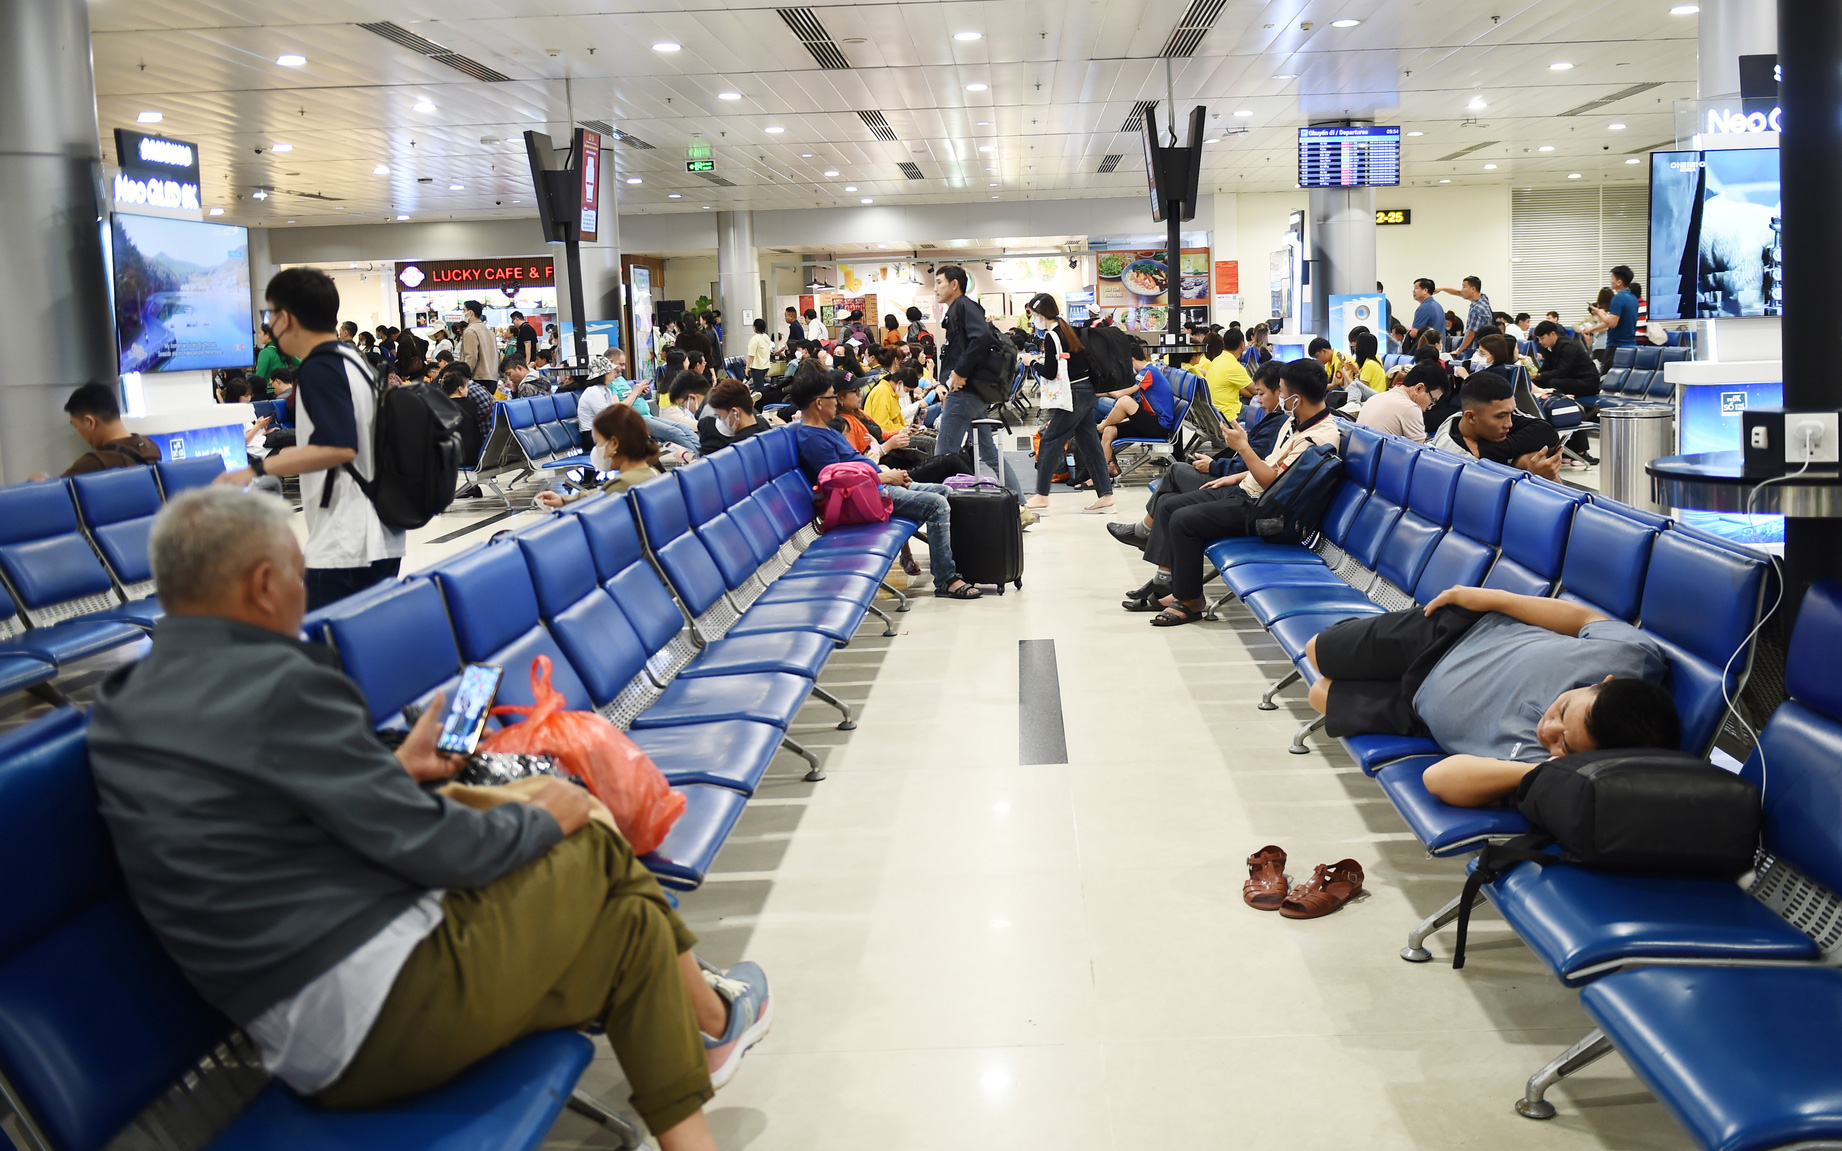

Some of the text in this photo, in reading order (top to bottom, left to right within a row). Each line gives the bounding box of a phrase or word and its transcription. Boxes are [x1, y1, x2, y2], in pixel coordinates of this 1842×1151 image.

[1707, 107, 1767, 135] Neo
[432, 268, 482, 282] LUCKY
[484, 266, 524, 280] CAFE
[529, 266, 540, 279] &
